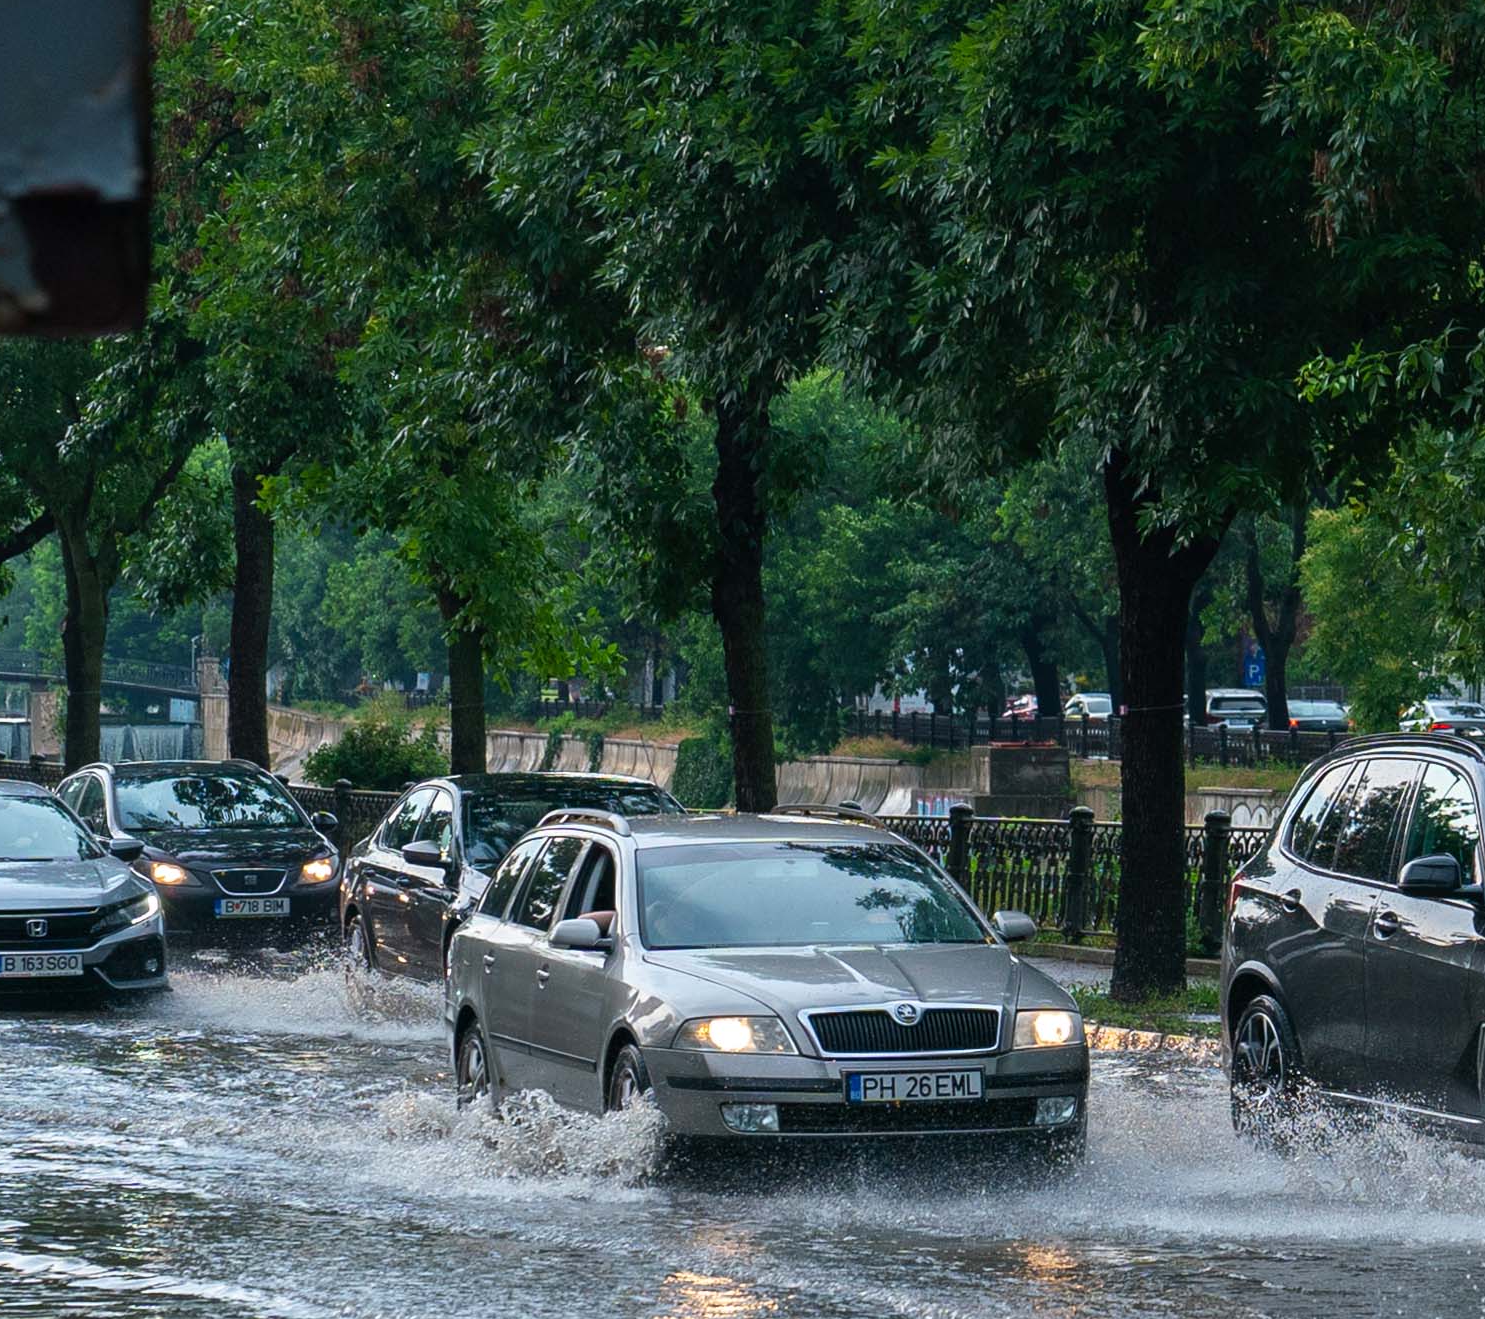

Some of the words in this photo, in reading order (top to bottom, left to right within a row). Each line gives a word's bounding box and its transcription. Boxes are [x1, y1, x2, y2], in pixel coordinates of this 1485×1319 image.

[1249, 664, 1260, 679] P
[226, 901, 235, 913] B
[239, 901, 260, 913] 718
[263, 900, 285, 913] BIM
[4, 957, 16, 971] B
[21, 957, 44, 971] 163
[46, 956, 78, 971] SGO
[863, 1077, 896, 1099] PH
[905, 1076, 932, 1098] 26
[936, 1074, 979, 1096] EML
